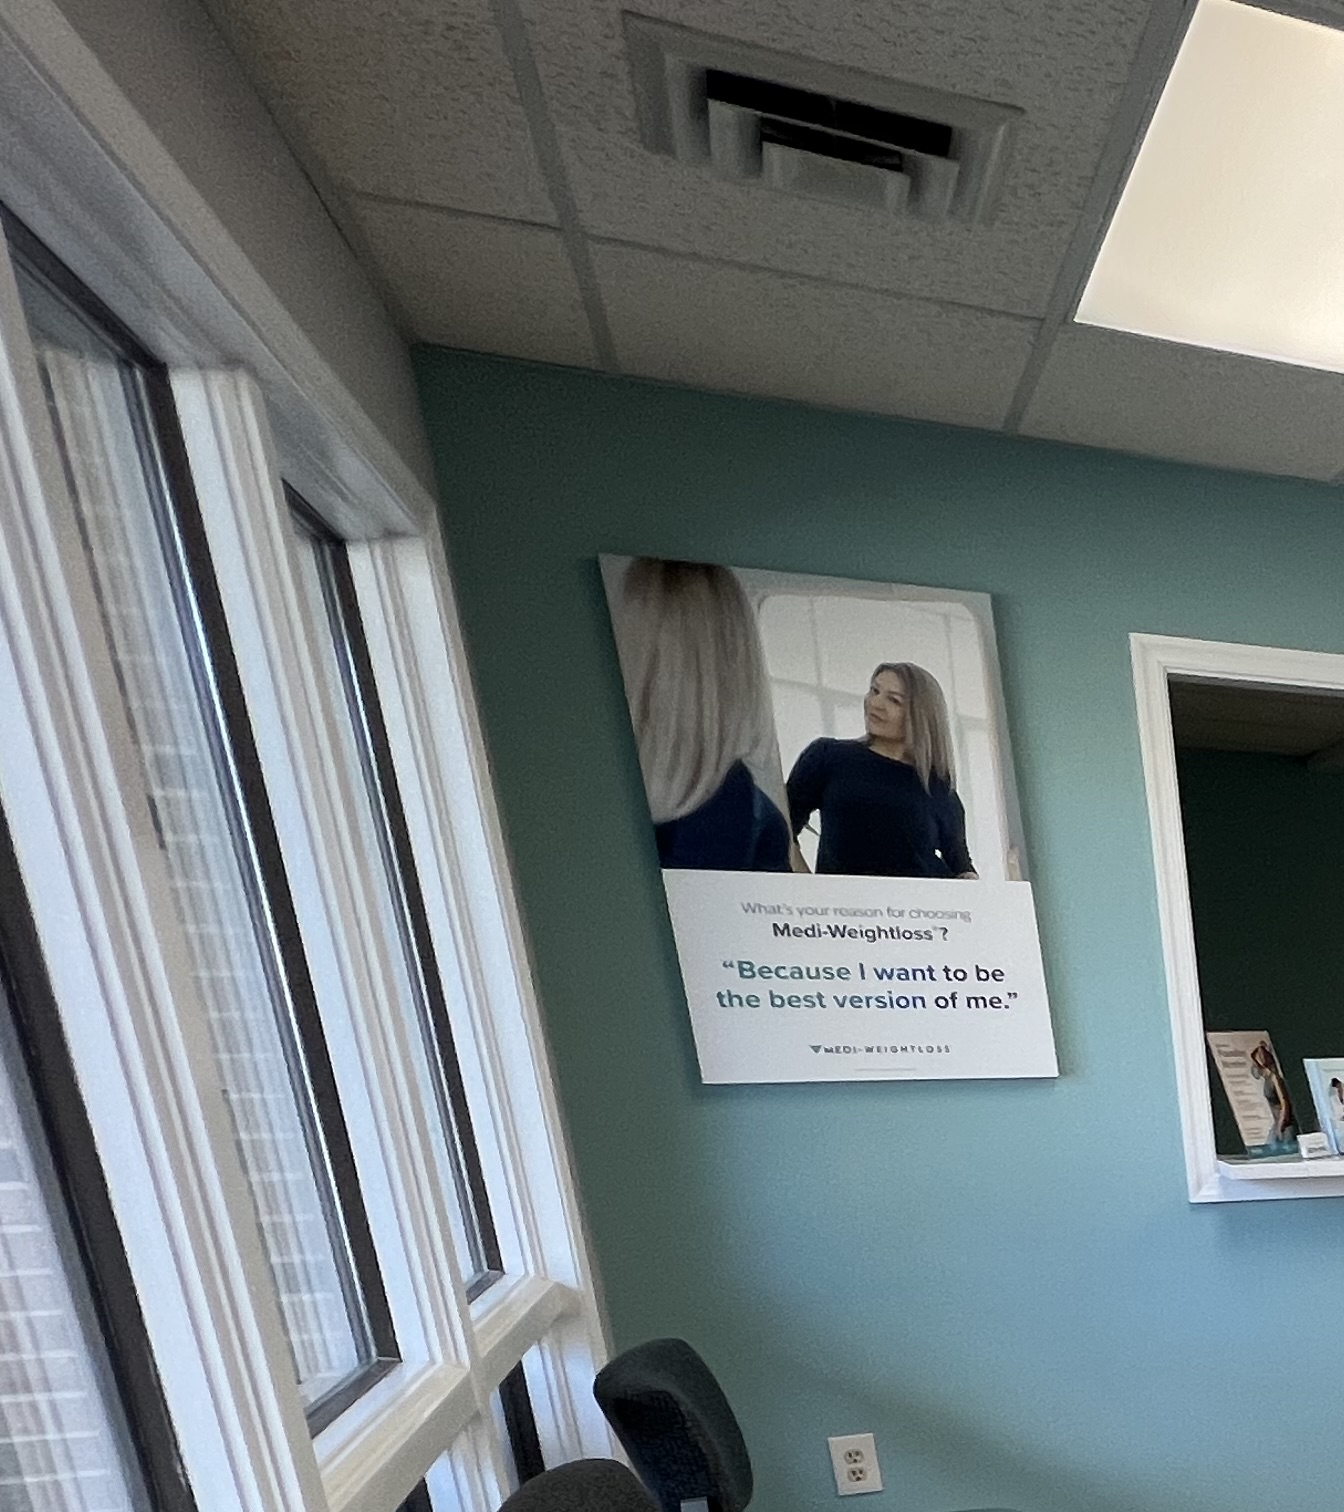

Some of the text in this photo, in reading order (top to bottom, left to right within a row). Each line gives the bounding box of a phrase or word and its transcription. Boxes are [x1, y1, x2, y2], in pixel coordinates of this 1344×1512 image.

[798, 906, 829, 919] your
[887, 906, 906, 919] for
[910, 907, 972, 923] choosing
[858, 963, 866, 981] I
[873, 964, 937, 982] want
[943, 965, 968, 982] to
[975, 964, 1005, 983] be
[716, 990, 760, 1009] the
[768, 990, 827, 1009] best
[833, 990, 927, 1009] version
[934, 991, 958, 1009] of
